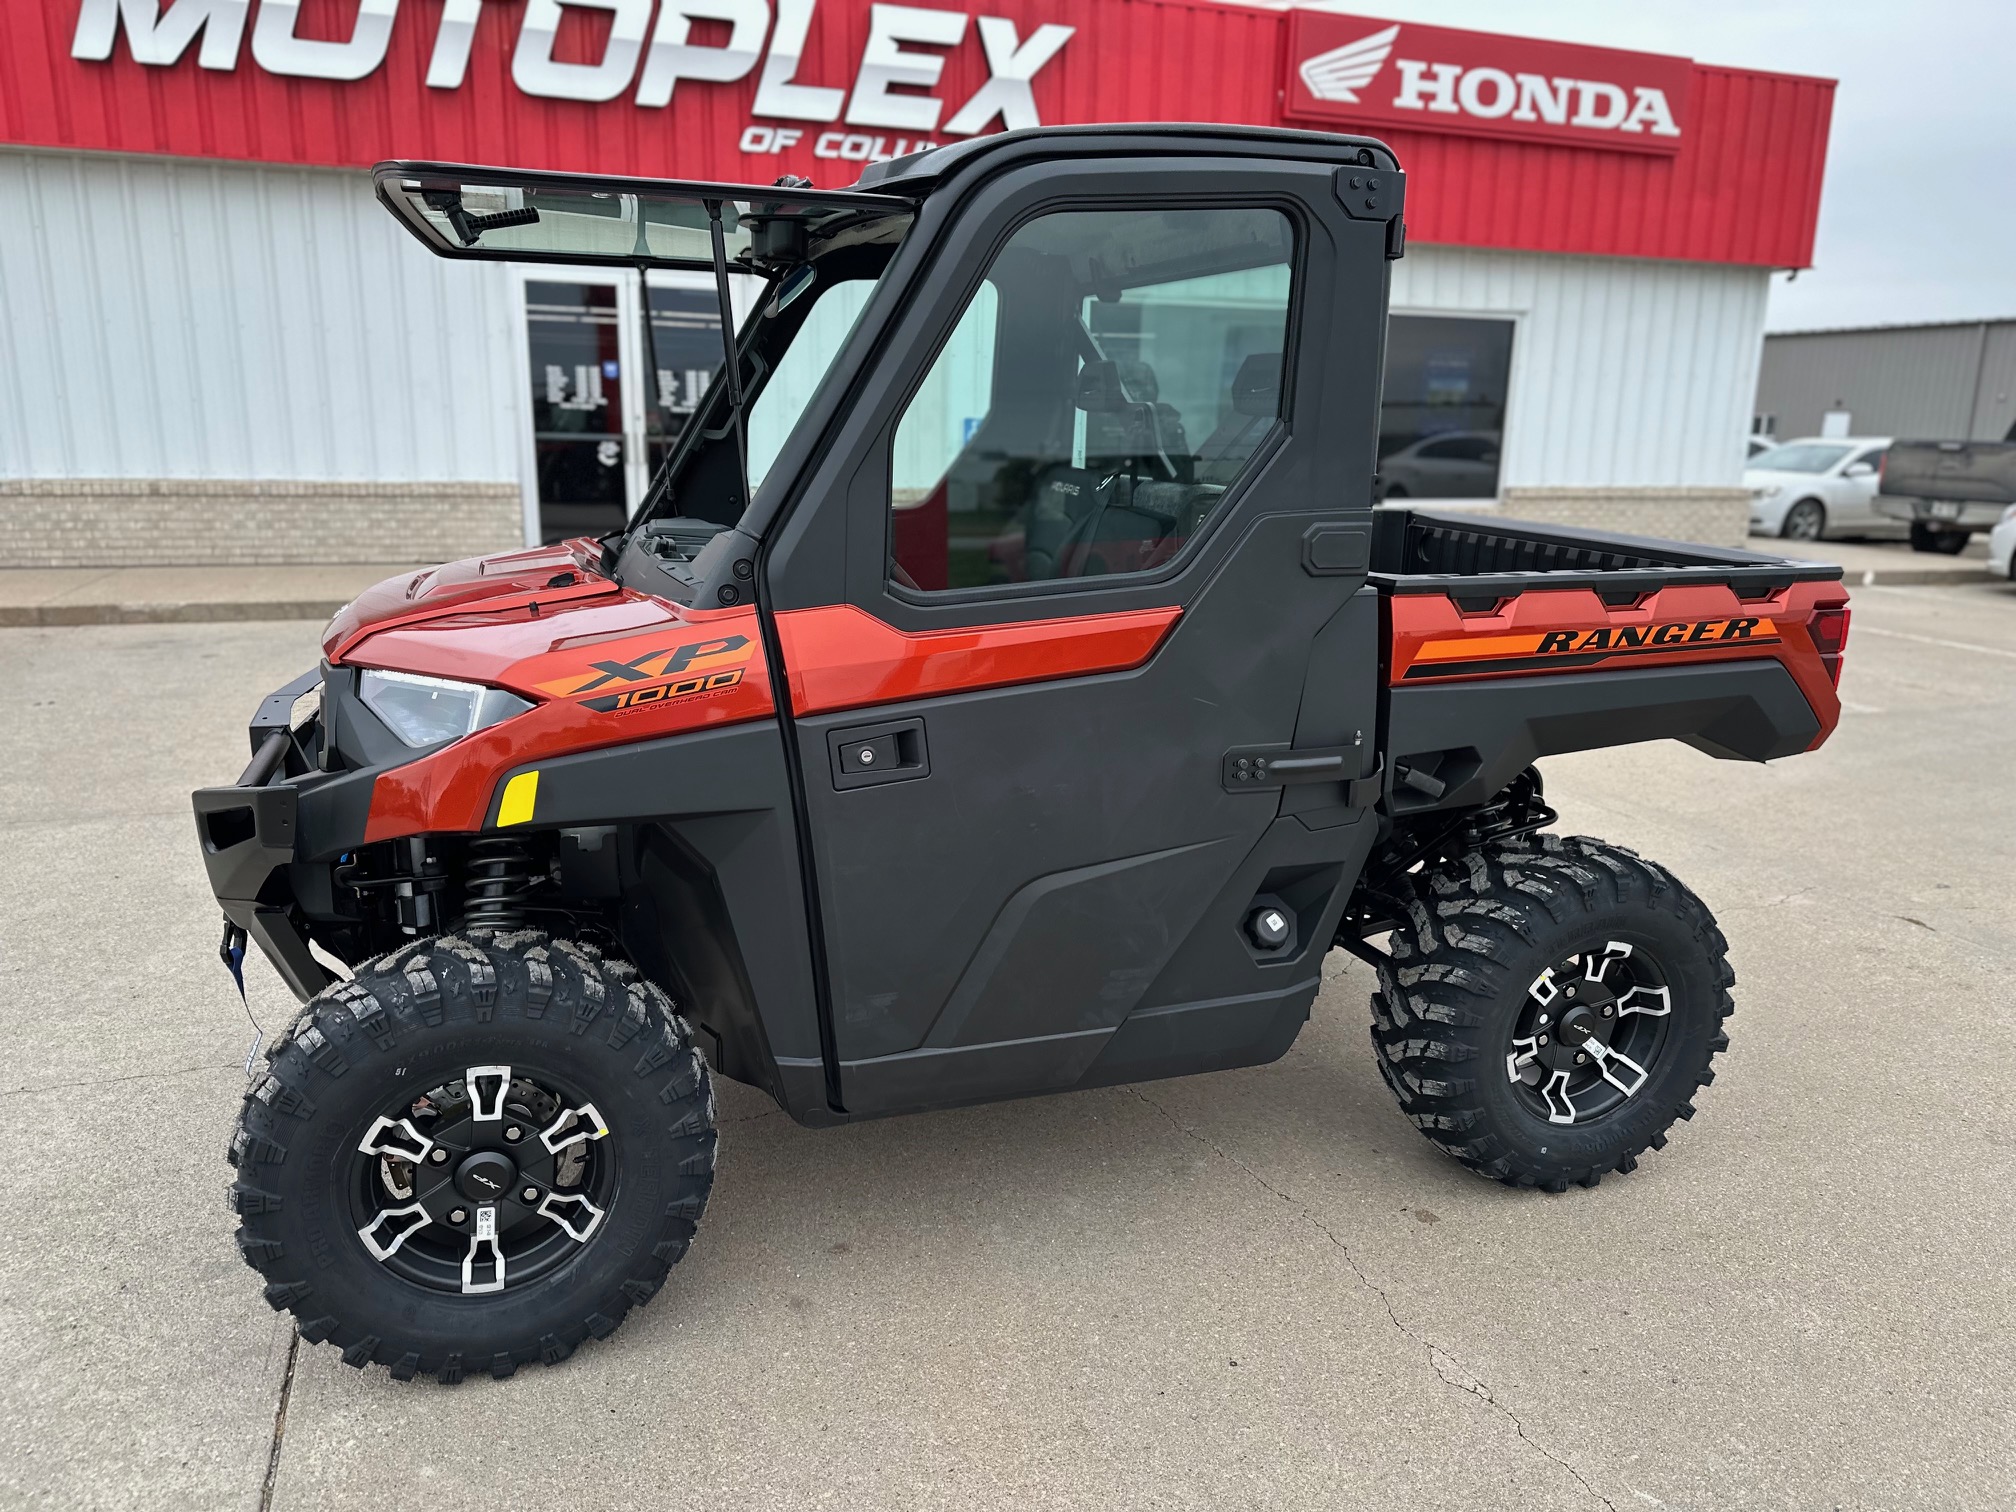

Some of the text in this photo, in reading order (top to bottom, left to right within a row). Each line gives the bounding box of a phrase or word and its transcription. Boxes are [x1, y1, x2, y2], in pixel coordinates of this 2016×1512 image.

[1393, 59, 1681, 137] HONDA
[739, 125, 938, 163] OF COLU
[1536, 617, 1760, 654] RANGER
[566, 634, 750, 695] XP
[614, 687, 738, 718] DUAL OVERHEAD CAM
[616, 669, 743, 709] 1000
[472, 1174, 501, 1190] XP
